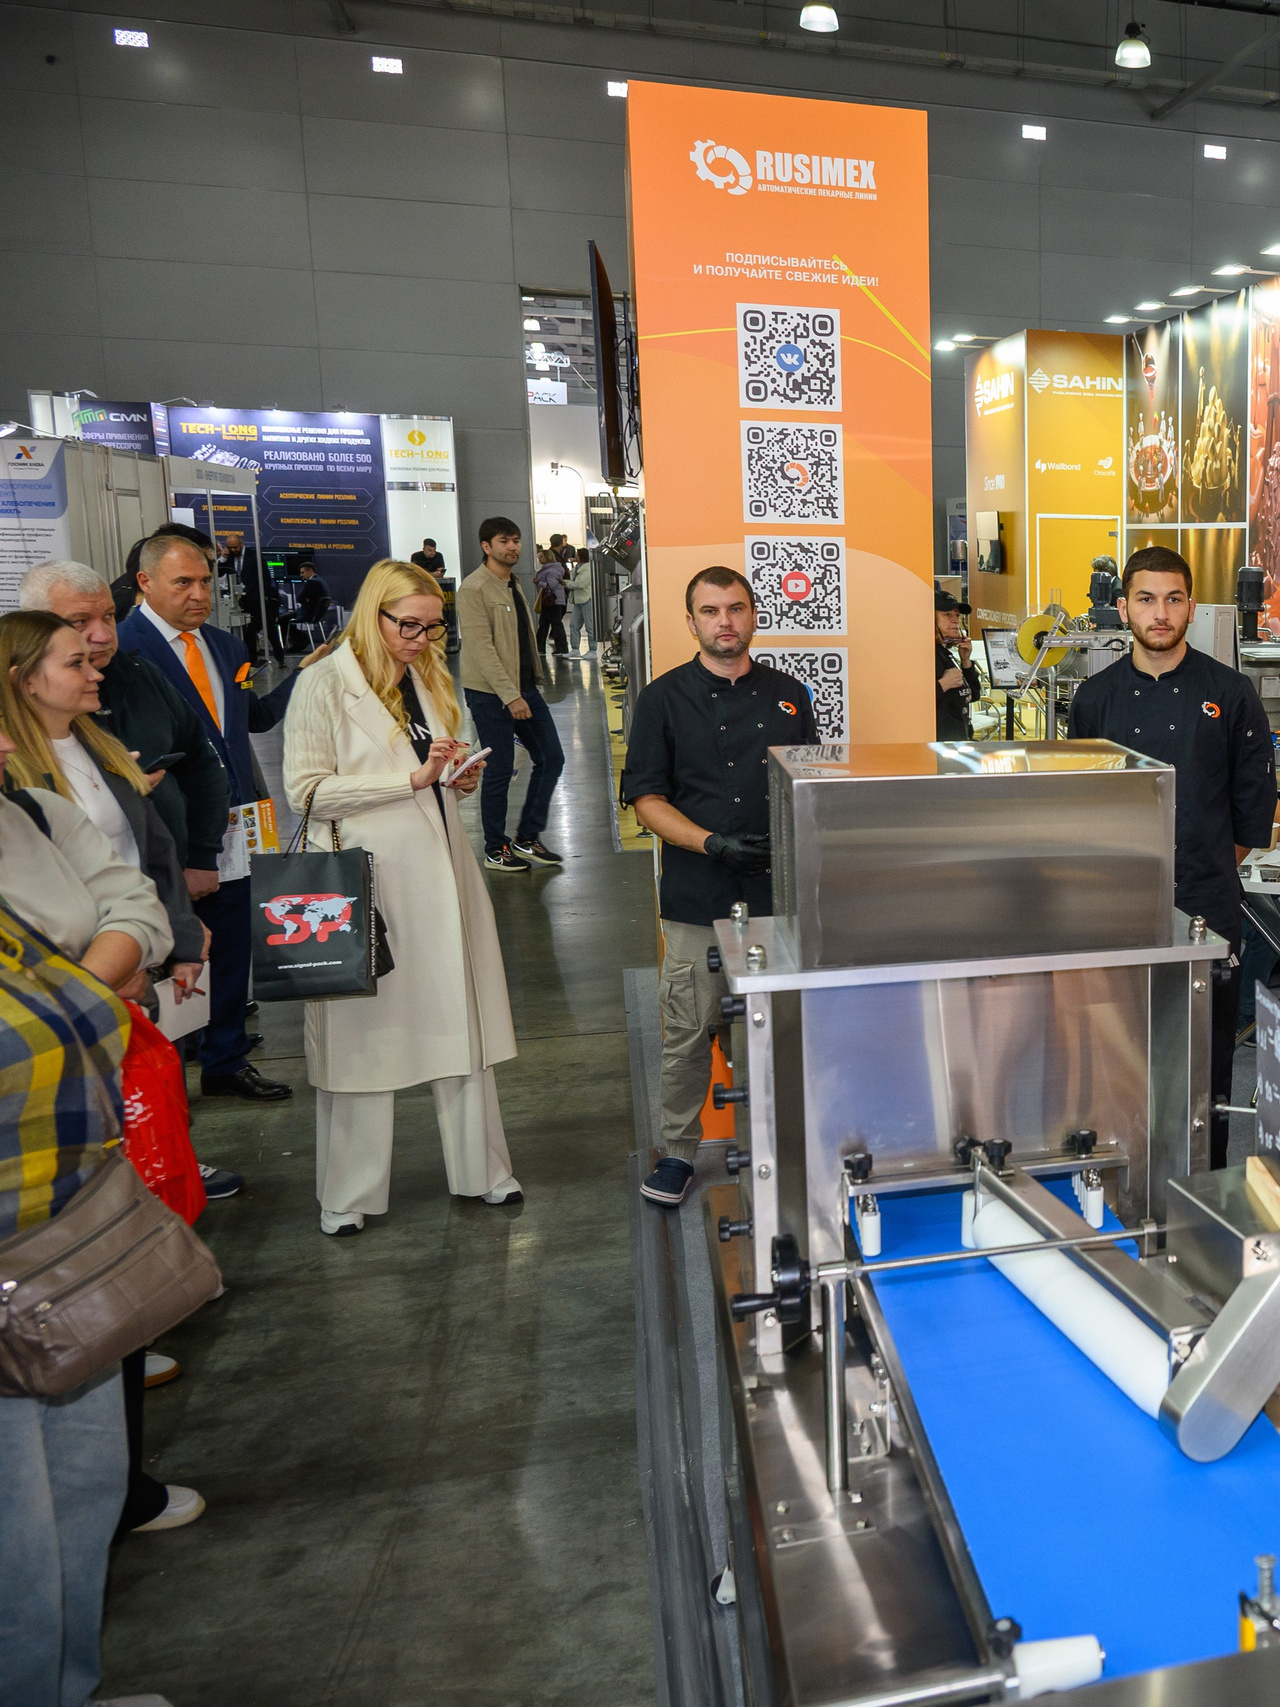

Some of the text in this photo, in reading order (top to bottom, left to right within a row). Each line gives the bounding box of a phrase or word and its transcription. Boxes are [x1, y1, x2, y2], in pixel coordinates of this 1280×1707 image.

[756, 150, 877, 190] RUSIMEX
[757, 184, 877, 201] АВТОМАТИЧЕСКИЕ ПЕКАРНЫЕ ЛИНИИ
[726, 252, 848, 271] ПОДПИСЫВАЙТЕСЬ
[693, 264, 879, 287] И ПОЛУЧАЙТЕ СВЕЖИЕ ИДЕИ!
[109, 412, 148, 422] CMN
[180, 423, 258, 436] TECH-LONG
[263, 450, 372, 463] РЕАЛИЗОВАНО БОЛЕЕ 500
[389, 449, 449, 459] TECH-LONG
[265, 463, 294, 471] КРУПНЫХ
[336, 465, 355, 473] ВСЕМУ
[278, 961, 342, 970] www.signal-pack.com
